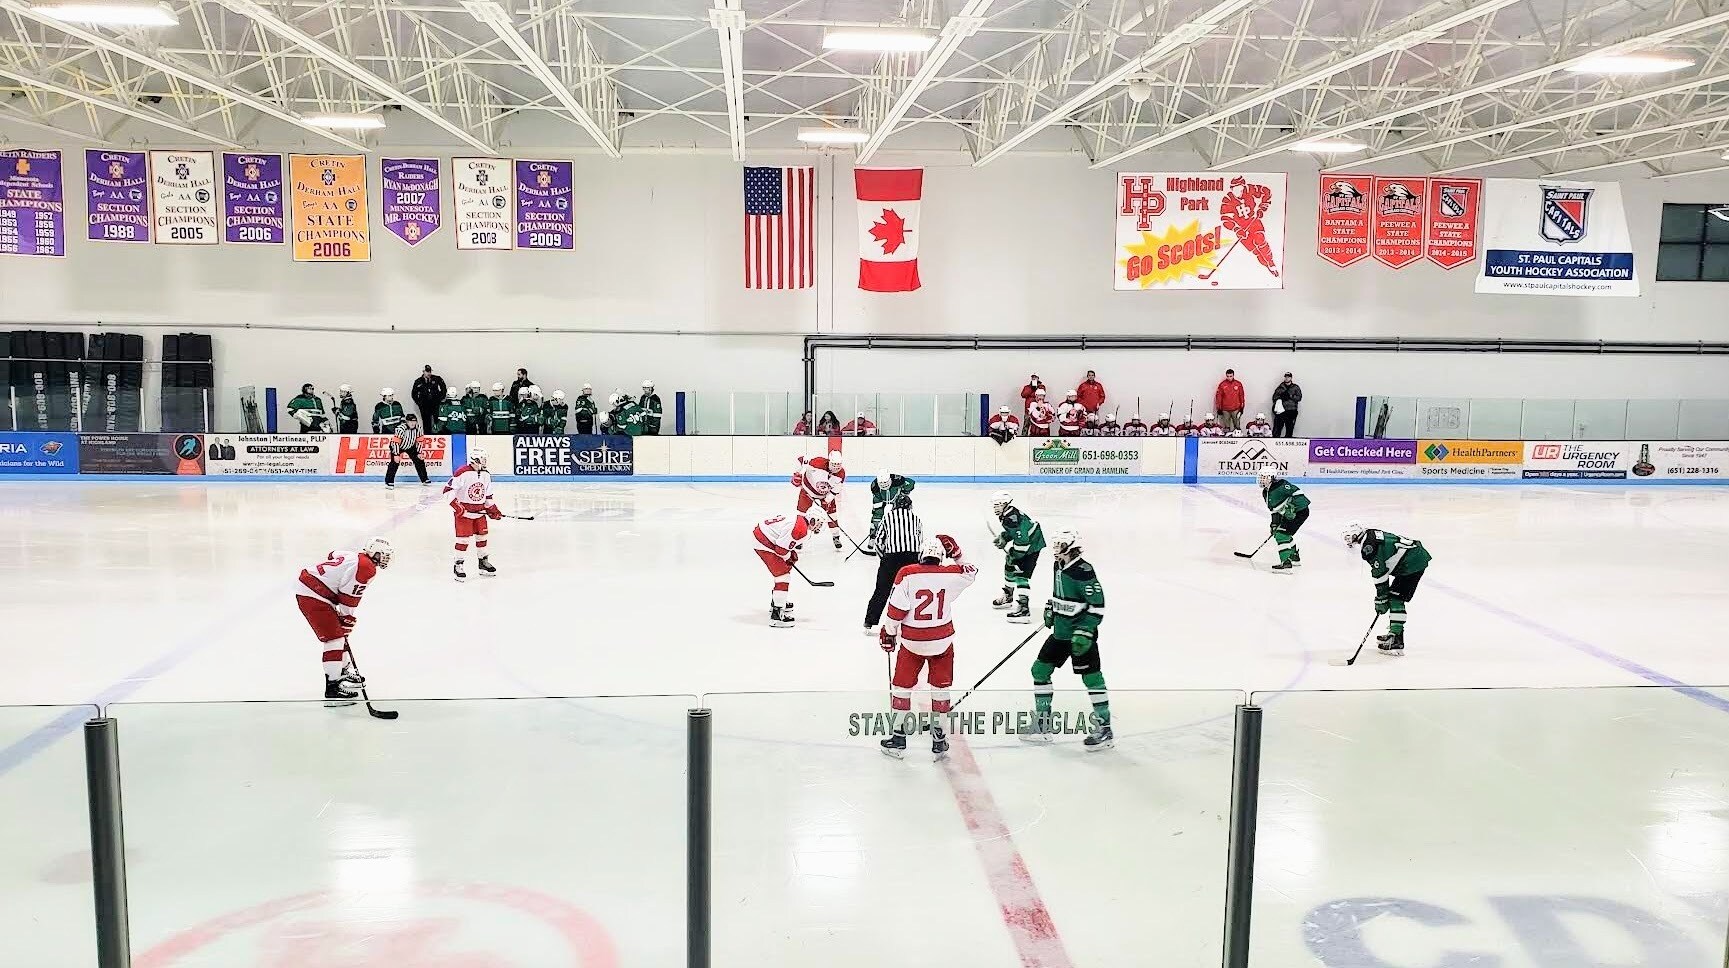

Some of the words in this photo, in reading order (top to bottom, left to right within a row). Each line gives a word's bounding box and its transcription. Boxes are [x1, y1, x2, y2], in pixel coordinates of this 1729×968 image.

[22, 151, 57, 160] RAIDERS
[100, 152, 130, 164] CRETIN
[167, 155, 197, 164] CRETIN
[237, 155, 268, 166] CRETIN
[310, 159, 346, 169] CRETIN
[529, 163, 559, 173] CRETIN
[90, 172, 122, 188] DERHAM
[123, 177, 146, 187] HALL
[157, 176, 188, 189] DERHAM
[190, 178, 212, 188] HALL
[227, 176, 258, 190] DERHAM
[259, 179, 281, 190] HALL
[383, 178, 402, 191] RYAN
[1166, 177, 1224, 193] Highland
[7, 189, 42, 200] STATE
[296, 181, 334, 197] DERHAM
[338, 185, 361, 196] HALL
[519, 182, 549, 196] DERHAM
[550, 186, 571, 196] HALL
[110, 191, 125, 200] AA
[178, 193, 192, 201] AA
[246, 194, 261, 202] AA
[397, 192, 426, 205] 2007
[1545, 190, 1568, 200] SAINT
[1568, 192, 1585, 200] PAUL
[0, 199, 63, 213] HAMPIONS
[97, 203, 140, 213] SECTION
[322, 202, 338, 210] AA
[390, 205, 434, 213] MINNESOTA
[538, 200, 551, 208] AA
[1180, 197, 1209, 211] Park
[34, 211, 54, 220] 1957
[165, 206, 207, 214] SECTION
[234, 206, 275, 215] SECTION
[89, 213, 148, 228] CHAMPIONS
[158, 216, 216, 228] CHAMPIONS
[226, 216, 283, 229] CHAMPIONS
[307, 215, 354, 226] STATE
[402, 213, 440, 226] HOCKEY
[525, 213, 565, 221] SECTION
[1544, 200, 1581, 239] CAPITALS
[35, 220, 54, 229] 1958
[459, 221, 510, 234] CHAMPIONS
[518, 222, 573, 236] CHAMPIONS
[1433, 221, 1463, 229] PEEWEE
[35, 229, 55, 237] 1959
[103, 224, 135, 239] 1988
[171, 227, 203, 240] 2005
[239, 227, 272, 241] 2006
[297, 230, 366, 243] CHAMPIONS
[35, 237, 55, 246] 1960
[530, 233, 562, 246] 2009
[1428, 239, 1473, 248] CHAMPIONS
[36, 246, 55, 254] 1963
[313, 242, 351, 257] 2006
[1158, 226, 1221, 270] Scots!
[1451, 249, 1468, 257] 2015
[1518, 254, 1531, 264] ST.
[1533, 255, 1556, 265] PAUL
[1557, 255, 1602, 265] CAPITALS
[1490, 265, 1523, 276] YOUTH
[1525, 266, 1563, 277] HOCKEY
[1565, 268, 1629, 278] ASSOCIATION
[1503, 282, 1612, 291] www.stpaulcapitalshockey.com
[516, 437, 571, 447] ALWAYS
[0, 443, 28, 453] RIA
[1315, 446, 1335, 457] Get
[1337, 446, 1383, 457] Checked
[1385, 447, 1412, 458] Here
[1452, 447, 1516, 457] HealthPartners
[1533, 445, 1560, 459] UR
[515, 448, 572, 465] FREE
[580, 448, 631, 464] SPIRE
[1059, 450, 1078, 459] Mill
[1082, 451, 1139, 460] 651-698-0353
[1562, 452, 1620, 460] URGENCY
[516, 466, 572, 475] CHECKING
[1040, 467, 1064, 475] CORNER
[1065, 467, 1073, 475] OF
[1074, 467, 1095, 475] GRAND
[1095, 467, 1101, 475] &
[1102, 467, 1129, 475] HAMLINE
[352, 585, 366, 595] 12
[914, 588, 946, 621] 21
[848, 712, 898, 736] STAY
[906, 712, 941, 736] OFF
[947, 712, 986, 735] THE
